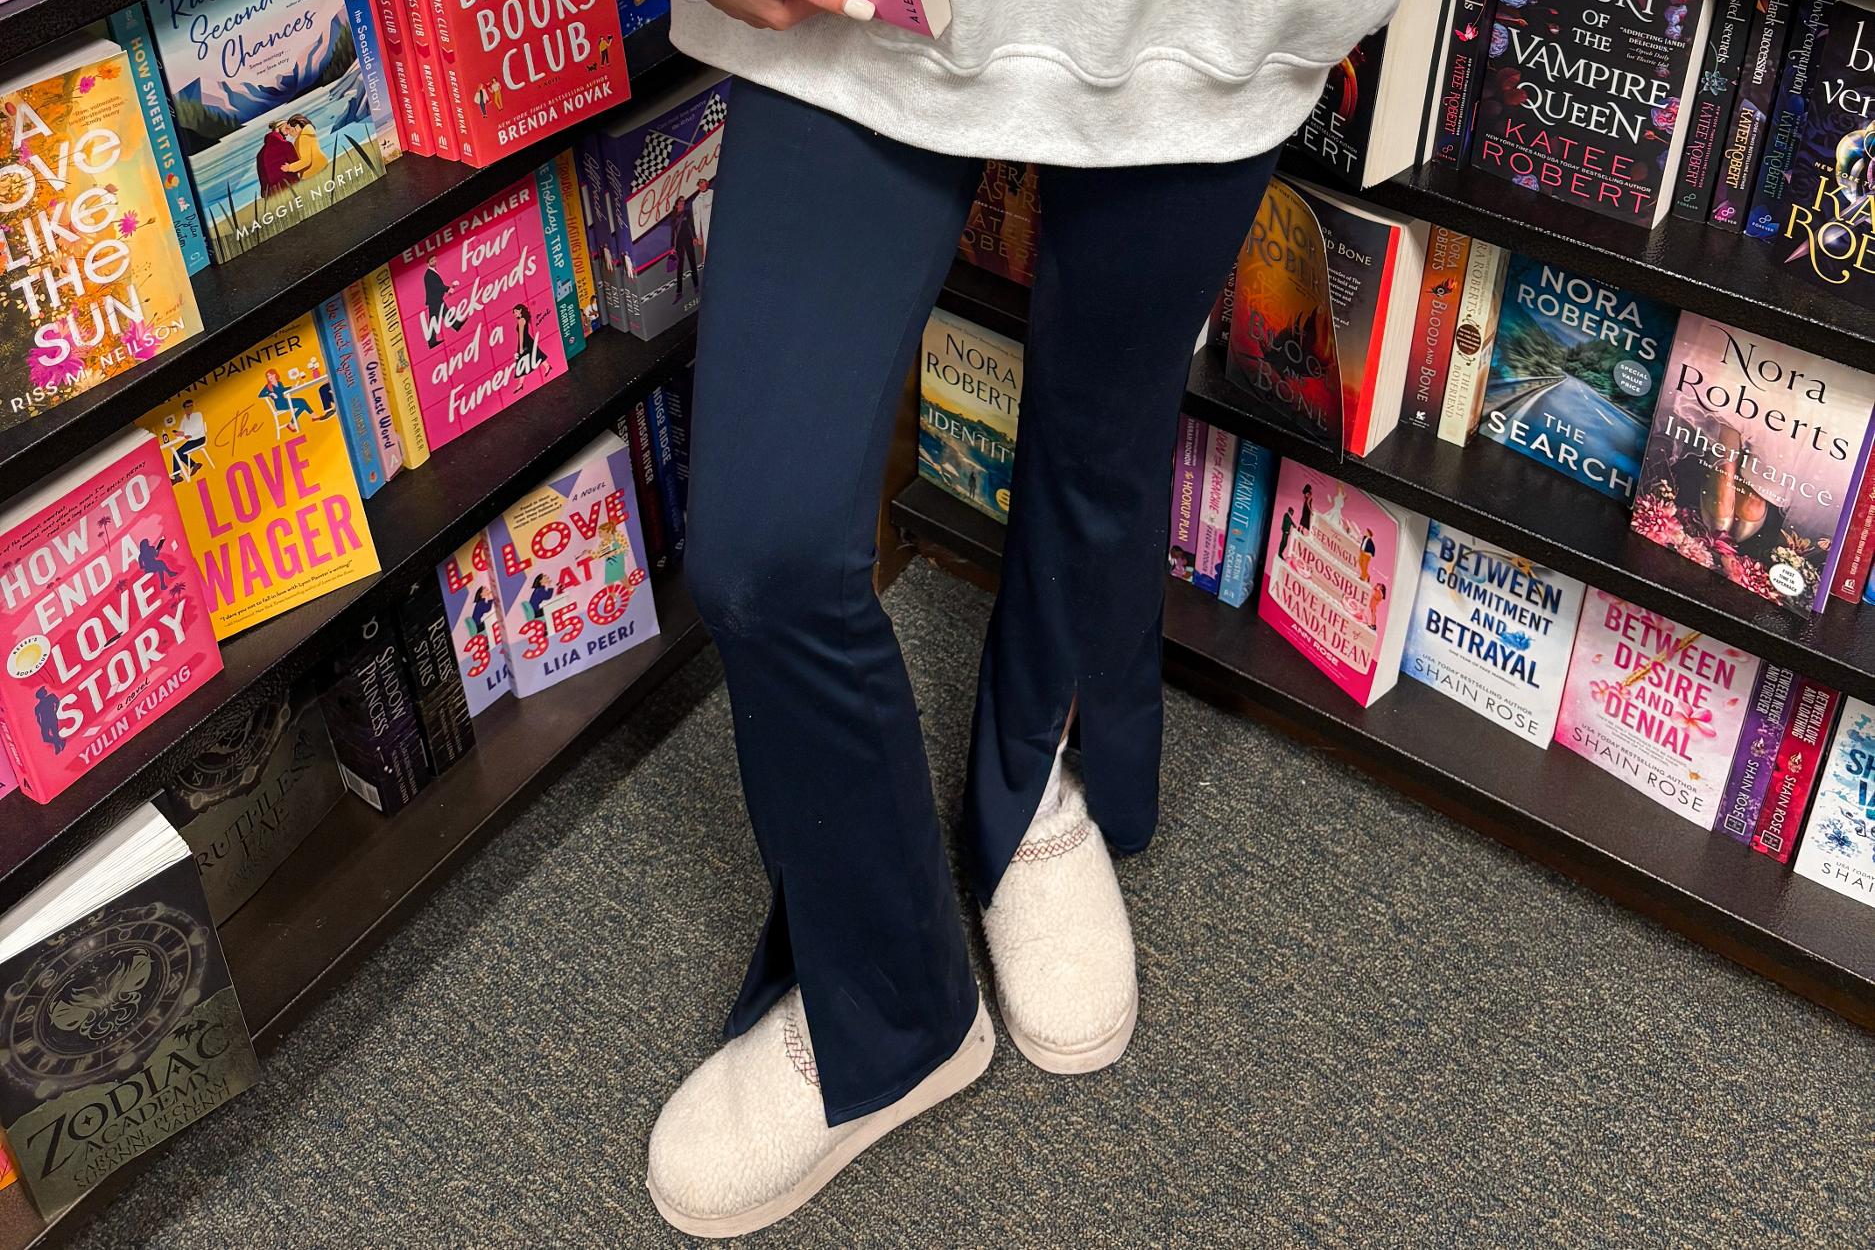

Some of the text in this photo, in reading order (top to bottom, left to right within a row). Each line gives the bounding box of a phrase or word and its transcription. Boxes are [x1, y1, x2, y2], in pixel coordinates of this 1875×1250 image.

[222, 10, 316, 78] Chances
[1573, 27, 1612, 53] THE
[1582, 8, 1611, 28] OF
[1716, 24, 1737, 64] secrets
[354, 10, 382, 111] the Seaside Library
[503, 22, 591, 92] CLUB
[1509, 28, 1672, 109] VAMPIRE
[132, 37, 175, 174] HOW SWEET IT IS
[497, 82, 613, 146] BRENDA NOVAK
[1516, 80, 1646, 144] QUEEN
[1482, 143, 1653, 214] ROBERT
[1486, 133, 1652, 192] NEW YORK TIMES AND USA TODAY BESTSELLING AUTHOR
[1503, 119, 1635, 180] KATEE
[235, 162, 365, 241] MAGGIE NORTH
[402, 186, 531, 263] ELLIE PALMER
[460, 223, 516, 273] Four
[33, 282, 143, 367] SUN
[419, 251, 537, 343] Weekends
[1431, 299, 1448, 348] BLOOD
[1517, 284, 1659, 360] ROBERTS
[1540, 265, 1643, 329] NORA
[101, 316, 186, 371] NEILSON
[210, 334, 303, 384] PAINTER
[432, 323, 505, 387] and a
[1619, 364, 1649, 380] SPECIAL
[1621, 373, 1643, 386] VALUE
[1710, 325, 1826, 404] Nora
[447, 348, 546, 423] Funeral
[1416, 366, 1437, 402] BONE
[1620, 380, 1641, 393] PRICE
[1675, 364, 1850, 461] Roberts
[214, 405, 265, 449] The
[1487, 410, 1633, 497] SEARCH
[1543, 413, 1586, 443] THE
[1664, 416, 1833, 507] Inheritance
[196, 434, 322, 538] LOVE
[2, 523, 95, 610] HOW
[108, 474, 151, 523] TO
[198, 498, 363, 614] WAGER
[502, 487, 632, 578] LOVE
[1310, 524, 1361, 568] SEEMINGLY
[36, 536, 141, 635] END A
[553, 557, 594, 596] AT
[1283, 572, 1350, 637] LOVE LIFE
[1291, 537, 1369, 607] IMPOSSIBLE
[1436, 568, 1553, 636] COMMITMENT
[1438, 535, 1562, 615] BETWEEN
[53, 576, 162, 679] LOVE
[518, 573, 646, 663] 350
[544, 620, 637, 677] LISA PEERS
[1272, 579, 1370, 668] AMANDA DEAN
[1291, 622, 1340, 668] ANN ROSE
[1425, 608, 1541, 690] BETRAYAL
[1470, 608, 1508, 637] AND
[1603, 604, 1736, 691] BETWEEN
[55, 599, 186, 736] STORY
[359, 662, 389, 738] PRINCESS
[376, 646, 404, 721] SHADOW
[1414, 657, 1538, 736] SHAIN ROSE
[1614, 641, 1712, 709] DESIRE
[1635, 686, 1675, 717] AND
[78, 666, 193, 766] YULIN KUANG
[1603, 690, 1694, 762] DENIAL
[1571, 727, 1639, 777] SHAIN
[1647, 771, 1703, 812] ROSE
[26, 1020, 232, 1180] ZODIAC
[87, 1072, 213, 1154] ACADEMY
